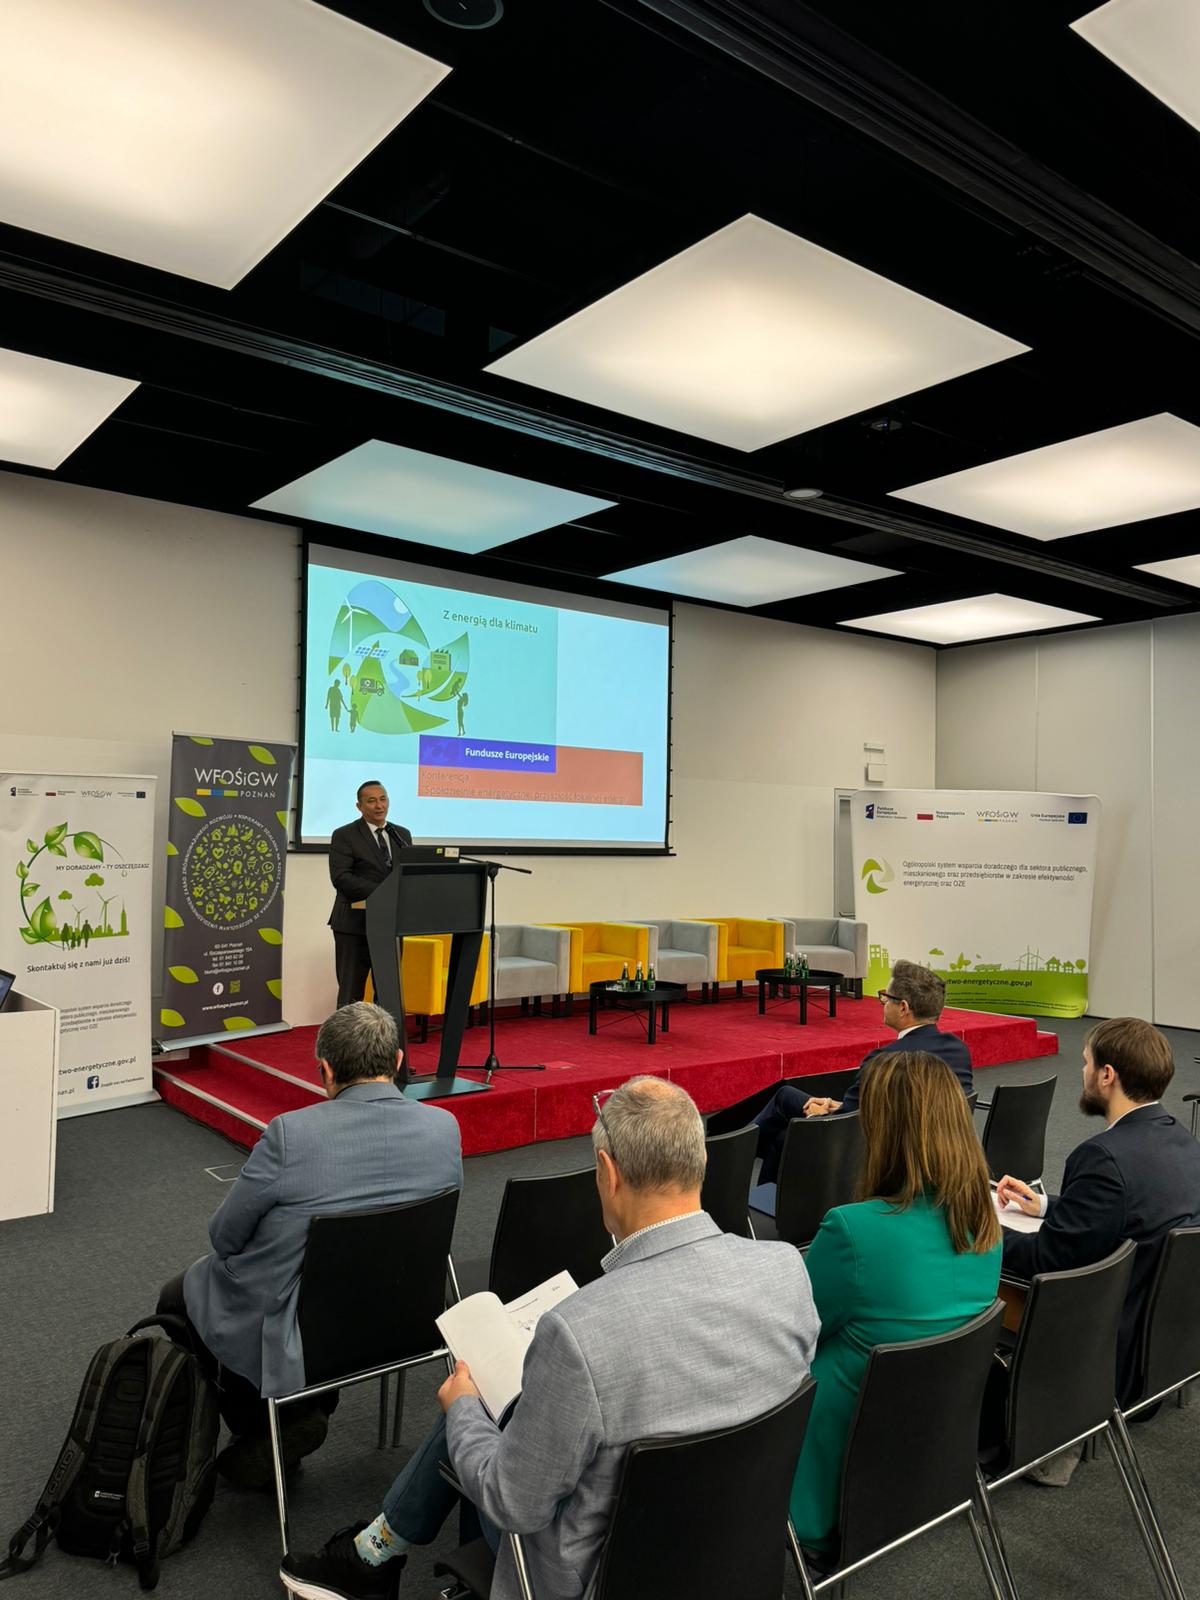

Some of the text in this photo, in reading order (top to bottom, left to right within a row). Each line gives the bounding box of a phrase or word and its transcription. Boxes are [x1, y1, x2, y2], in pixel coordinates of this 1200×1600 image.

[443, 610, 538, 633] Z energią dla klimatu
[465, 747, 550, 762] Fundusze Europejskie
[194, 767, 279, 787] WFOŚiGW
[240, 790, 276, 798] POZNAŃ
[976, 809, 1019, 818] WFOŚiGW
[902, 860, 936, 869] Ogólnopolski
[983, 863, 1018, 871] doradczego
[903, 871, 946, 879] mieszkaniowego
[953, 880, 967, 888] OZE
[27, 961, 67, 973] Skontaktuj
[68, 960, 78, 970] się
[85, 959, 102, 967] nami
[103, 957, 113, 967] już
[114, 956, 131, 965] dziś!
